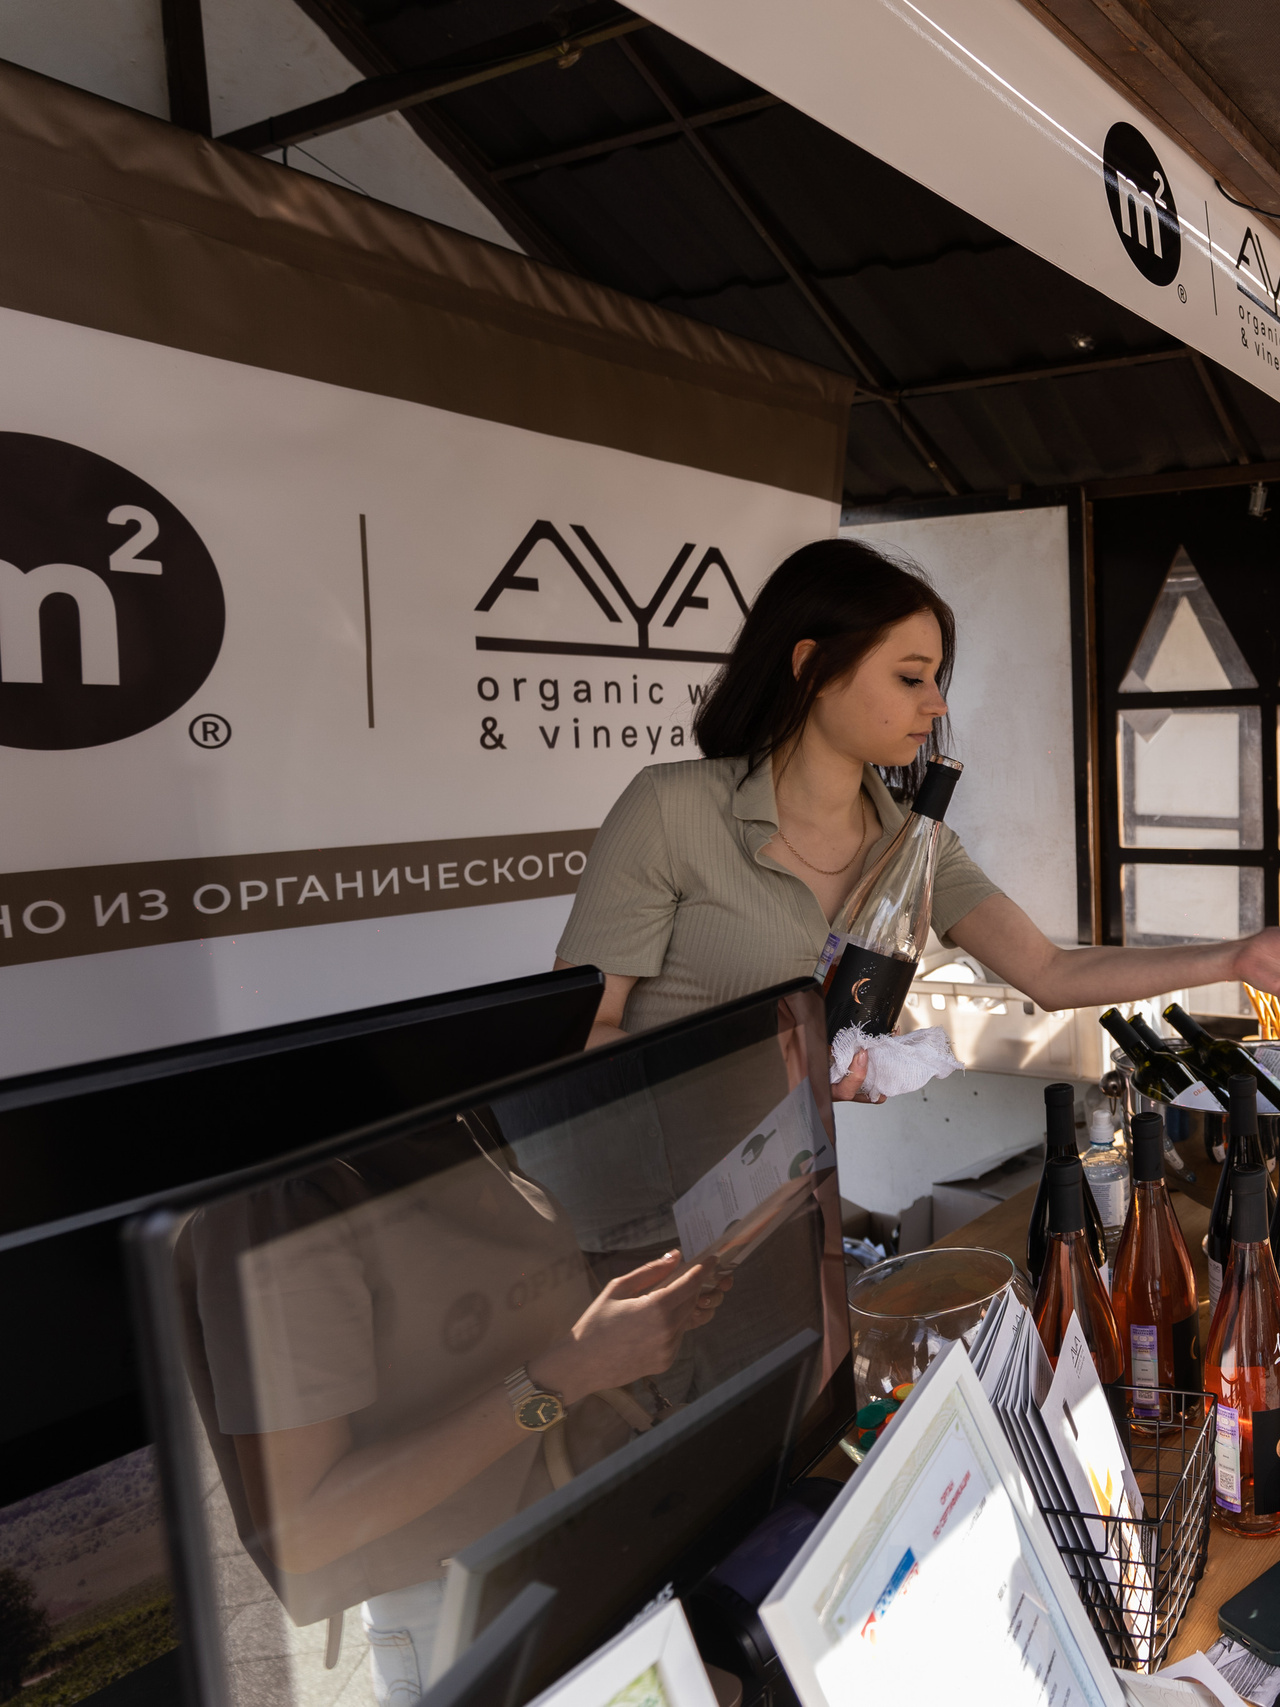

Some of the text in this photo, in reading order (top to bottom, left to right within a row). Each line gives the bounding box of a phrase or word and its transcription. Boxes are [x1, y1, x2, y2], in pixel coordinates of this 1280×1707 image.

[1241, 327, 1249, 349] &
[477, 674, 664, 711] organic
[479, 716, 507, 750] &
[93, 888, 169, 927] ИЗ
[192, 850, 587, 915] ОРГАНИЧЕСКОГО
